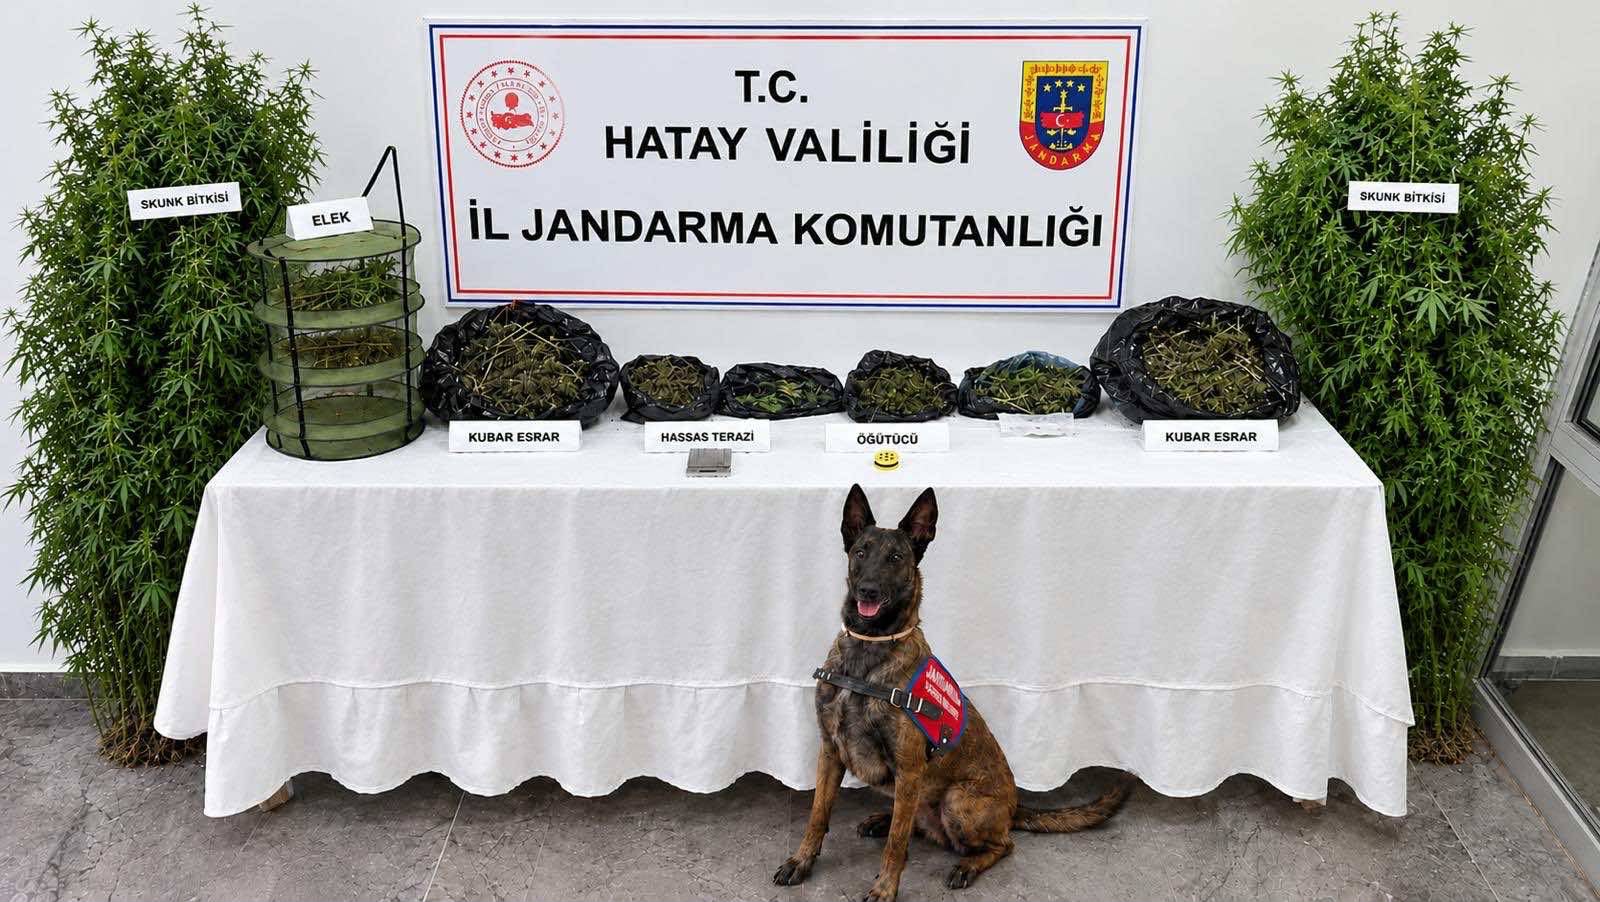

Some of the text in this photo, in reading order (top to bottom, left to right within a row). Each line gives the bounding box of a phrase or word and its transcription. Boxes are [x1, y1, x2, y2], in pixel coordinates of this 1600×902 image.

[735, 70, 808, 104] T.C.
[605, 120, 970, 165] HATAY VALİLİĞİ
[1024, 133, 1101, 167] JANDARMA
[140, 190, 230, 210] SKUNK BİTKİSİ
[1359, 190, 1446, 204] SKUNK BİTKİSİ
[311, 211, 351, 227] ELEK
[469, 198, 1103, 248] İL JANDARMA KOMUTANLIĞI
[468, 432, 560, 443] KUBAR ESRAR
[661, 429, 754, 443] HASSAS TERAZİ
[856, 430, 918, 445] ÖĞÜTÜCÜ
[1165, 431, 1257, 443] KUBAR ESRAR
